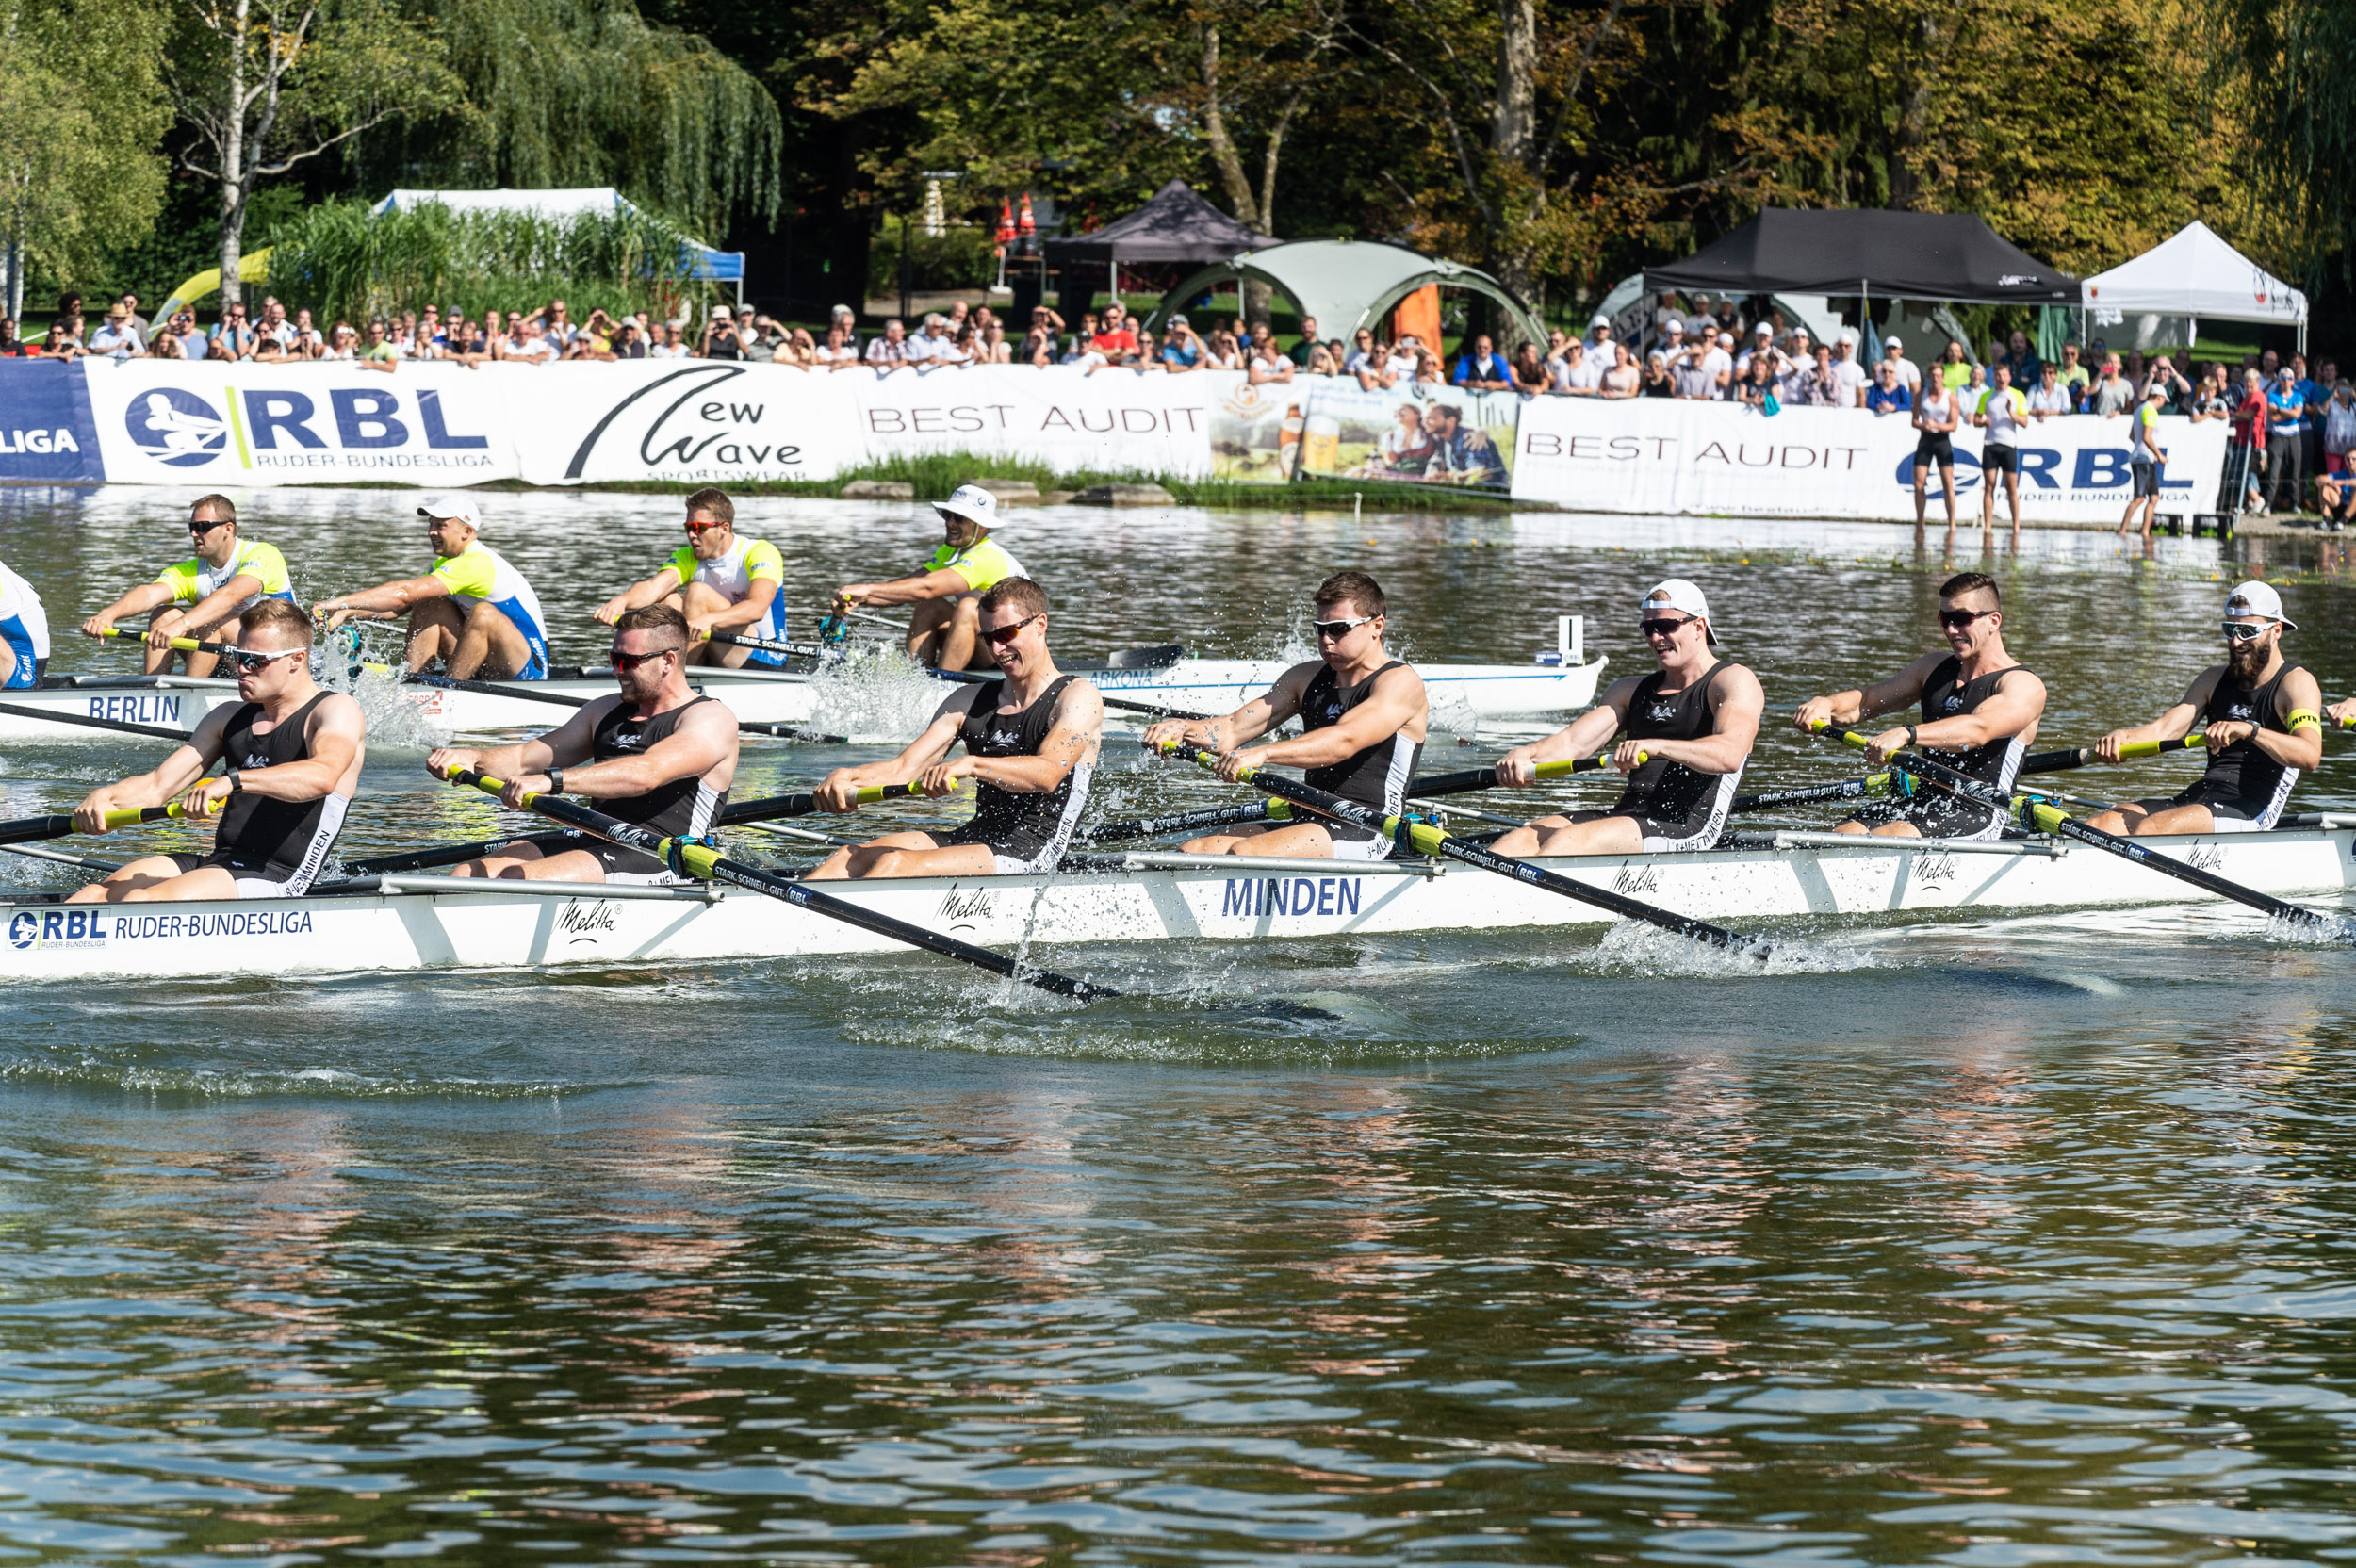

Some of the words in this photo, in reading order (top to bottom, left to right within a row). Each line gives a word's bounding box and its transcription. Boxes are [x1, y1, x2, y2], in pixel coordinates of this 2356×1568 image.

[243, 388, 489, 449] RBL
[868, 405, 1015, 433] BEST
[1040, 406, 1204, 433] AUDIT
[257, 454, 495, 467] RUDER-BUNDESLIGA
[1525, 433, 1677, 461] BEST
[1694, 441, 1868, 469] AUDIT
[736, 635, 761, 646] STARK.
[762, 640, 797, 652] SCHNELL.
[797, 645, 815, 655] GUT.
[1089, 670, 1153, 688] ARKONA
[90, 695, 180, 724] BERLIN
[1244, 805, 1264, 816] RBL
[2060, 822, 2082, 837] STARK.
[2082, 830, 2110, 848] SCHNELL.
[2110, 841, 2125, 854] GUT.
[2129, 846, 2146, 860] RBL
[2184, 838, 2222, 870] Melitta
[1518, 867, 1537, 881] RBL
[1609, 859, 1659, 895] Melitta
[1906, 849, 1955, 881] Melitta
[715, 866, 737, 882] STARK.
[738, 874, 769, 892] SCHNELL.
[769, 885, 785, 898] GUT.
[790, 890, 807, 905] RBL
[932, 881, 994, 920] Melitta
[1222, 878, 1361, 917] MINDEN
[42, 910, 106, 940] RBL
[115, 911, 313, 939] RUDER-BUNDESLIGA
[550, 896, 616, 934] Melitta
[41, 940, 106, 949] RUDER-BUNDESLIGA
